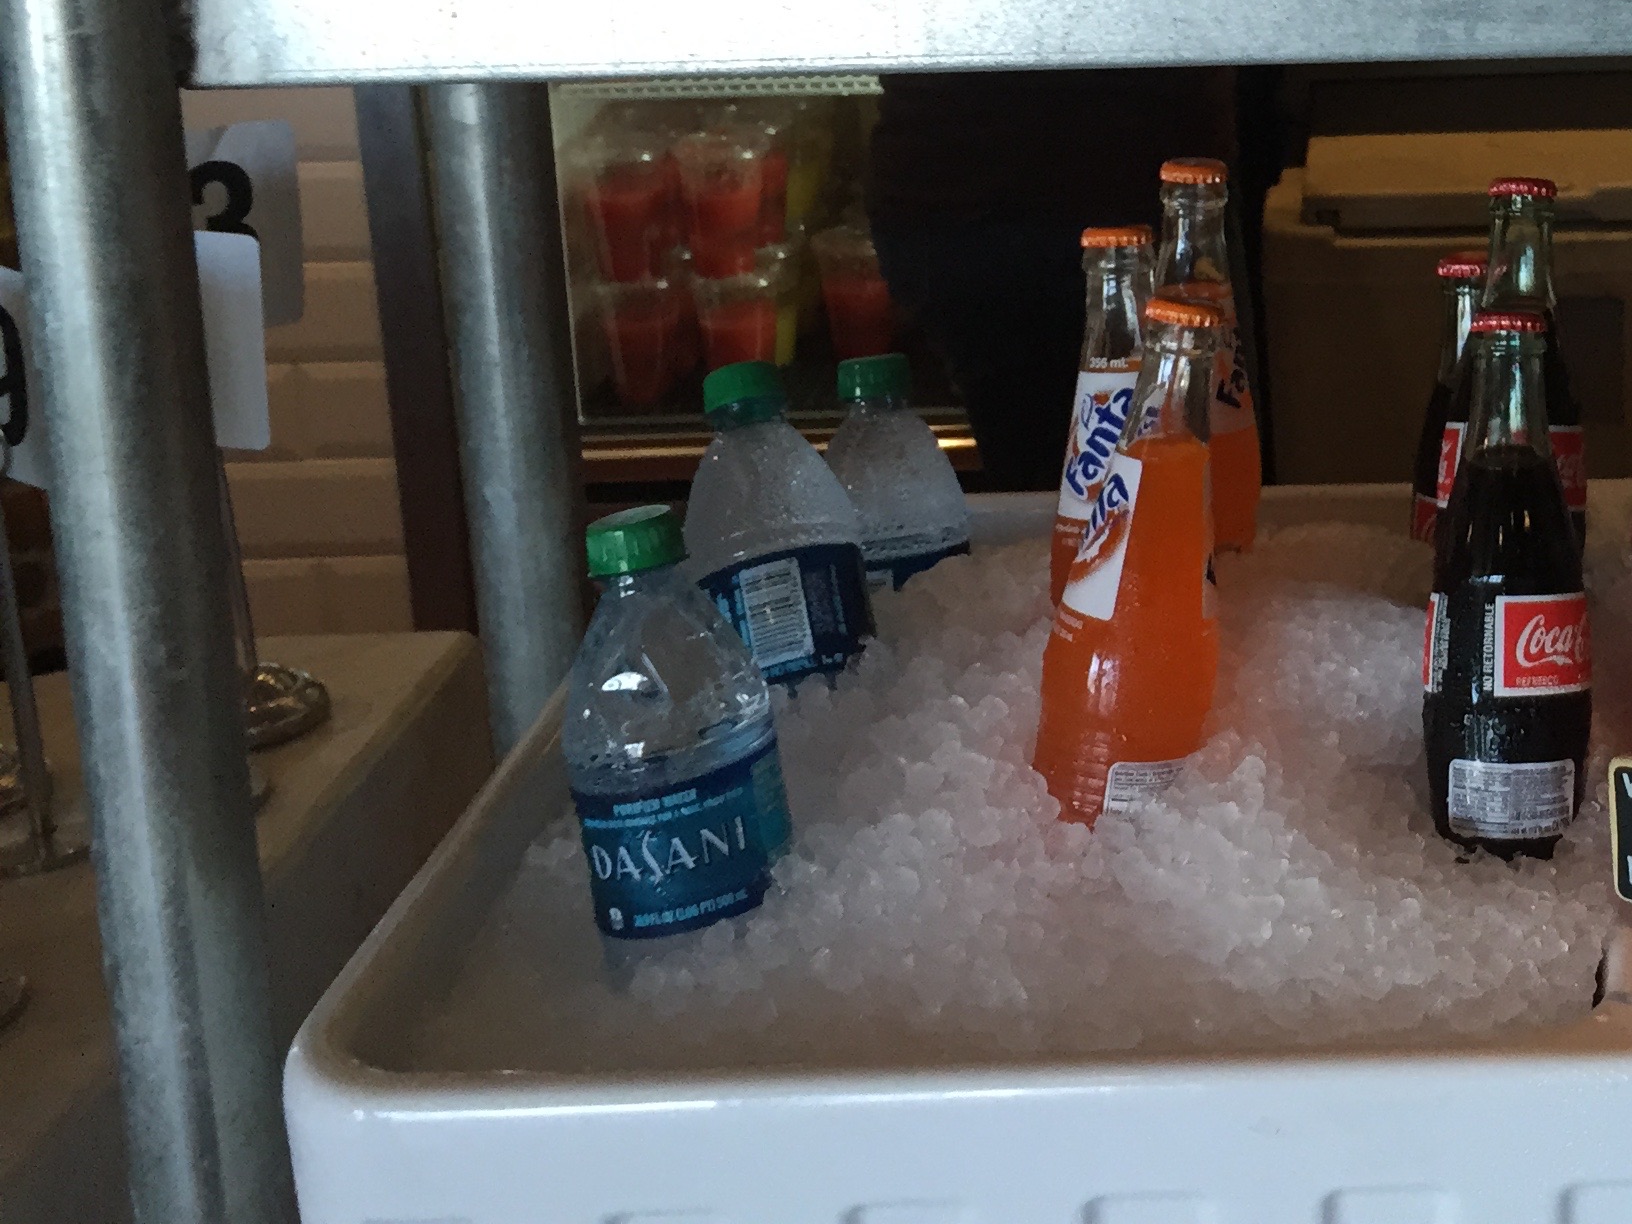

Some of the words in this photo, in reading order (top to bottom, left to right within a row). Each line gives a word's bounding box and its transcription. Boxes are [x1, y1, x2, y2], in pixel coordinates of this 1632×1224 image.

[1065, 387, 1134, 497] Fanta
[1482, 602, 1495, 674] RETORNABLE
[1482, 675, 1494, 692] NO
[590, 815, 747, 885] DASANI
